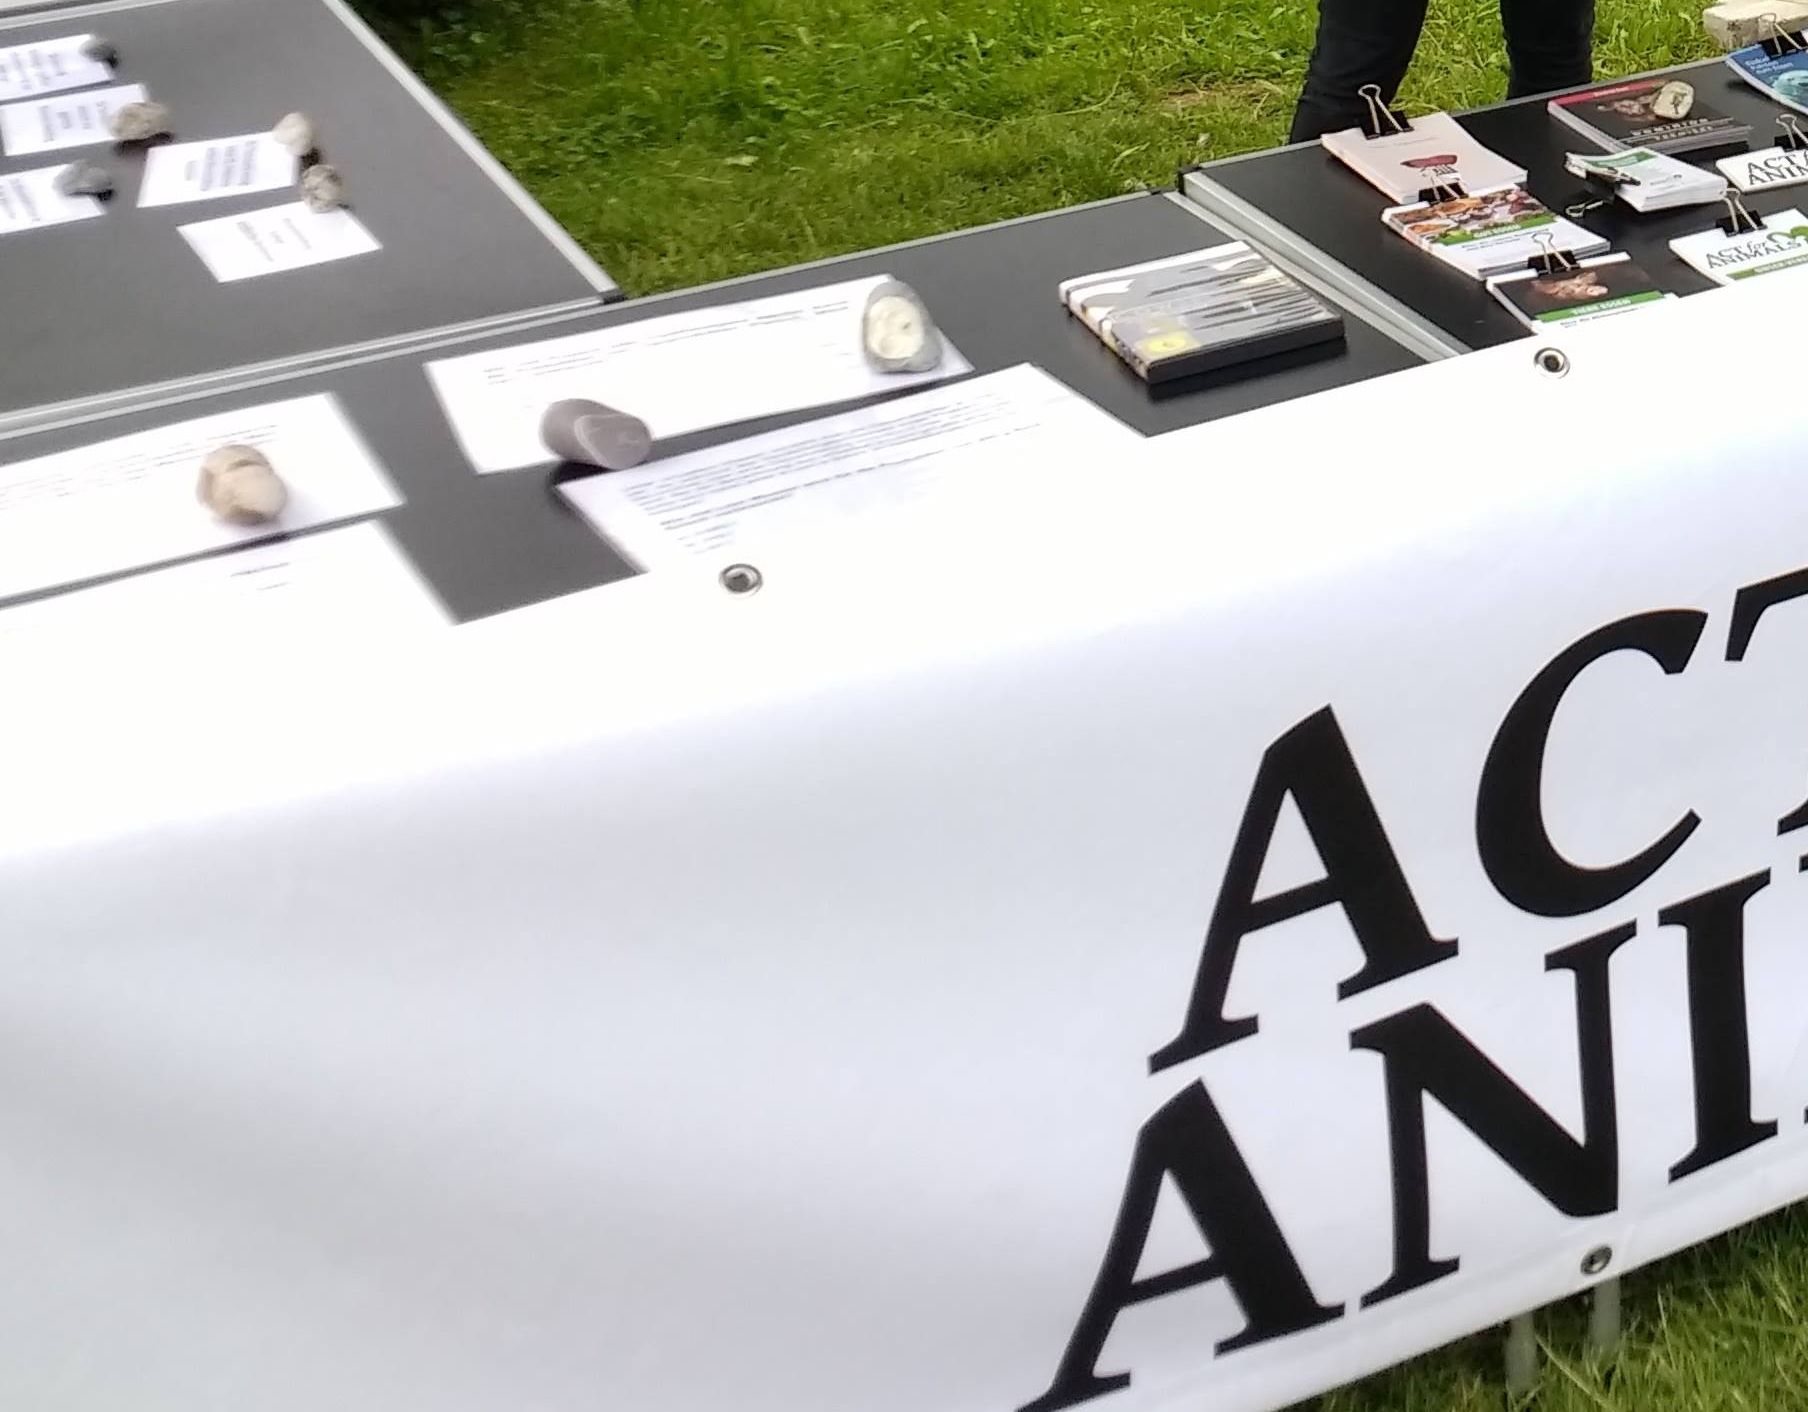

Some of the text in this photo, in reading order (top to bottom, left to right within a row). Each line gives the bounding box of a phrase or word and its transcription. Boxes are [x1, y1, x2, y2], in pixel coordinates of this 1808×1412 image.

[1747, 154, 1797, 174] ACT
[1705, 241, 1767, 262] ACT for
[1707, 240, 1802, 269] ANIMALS
